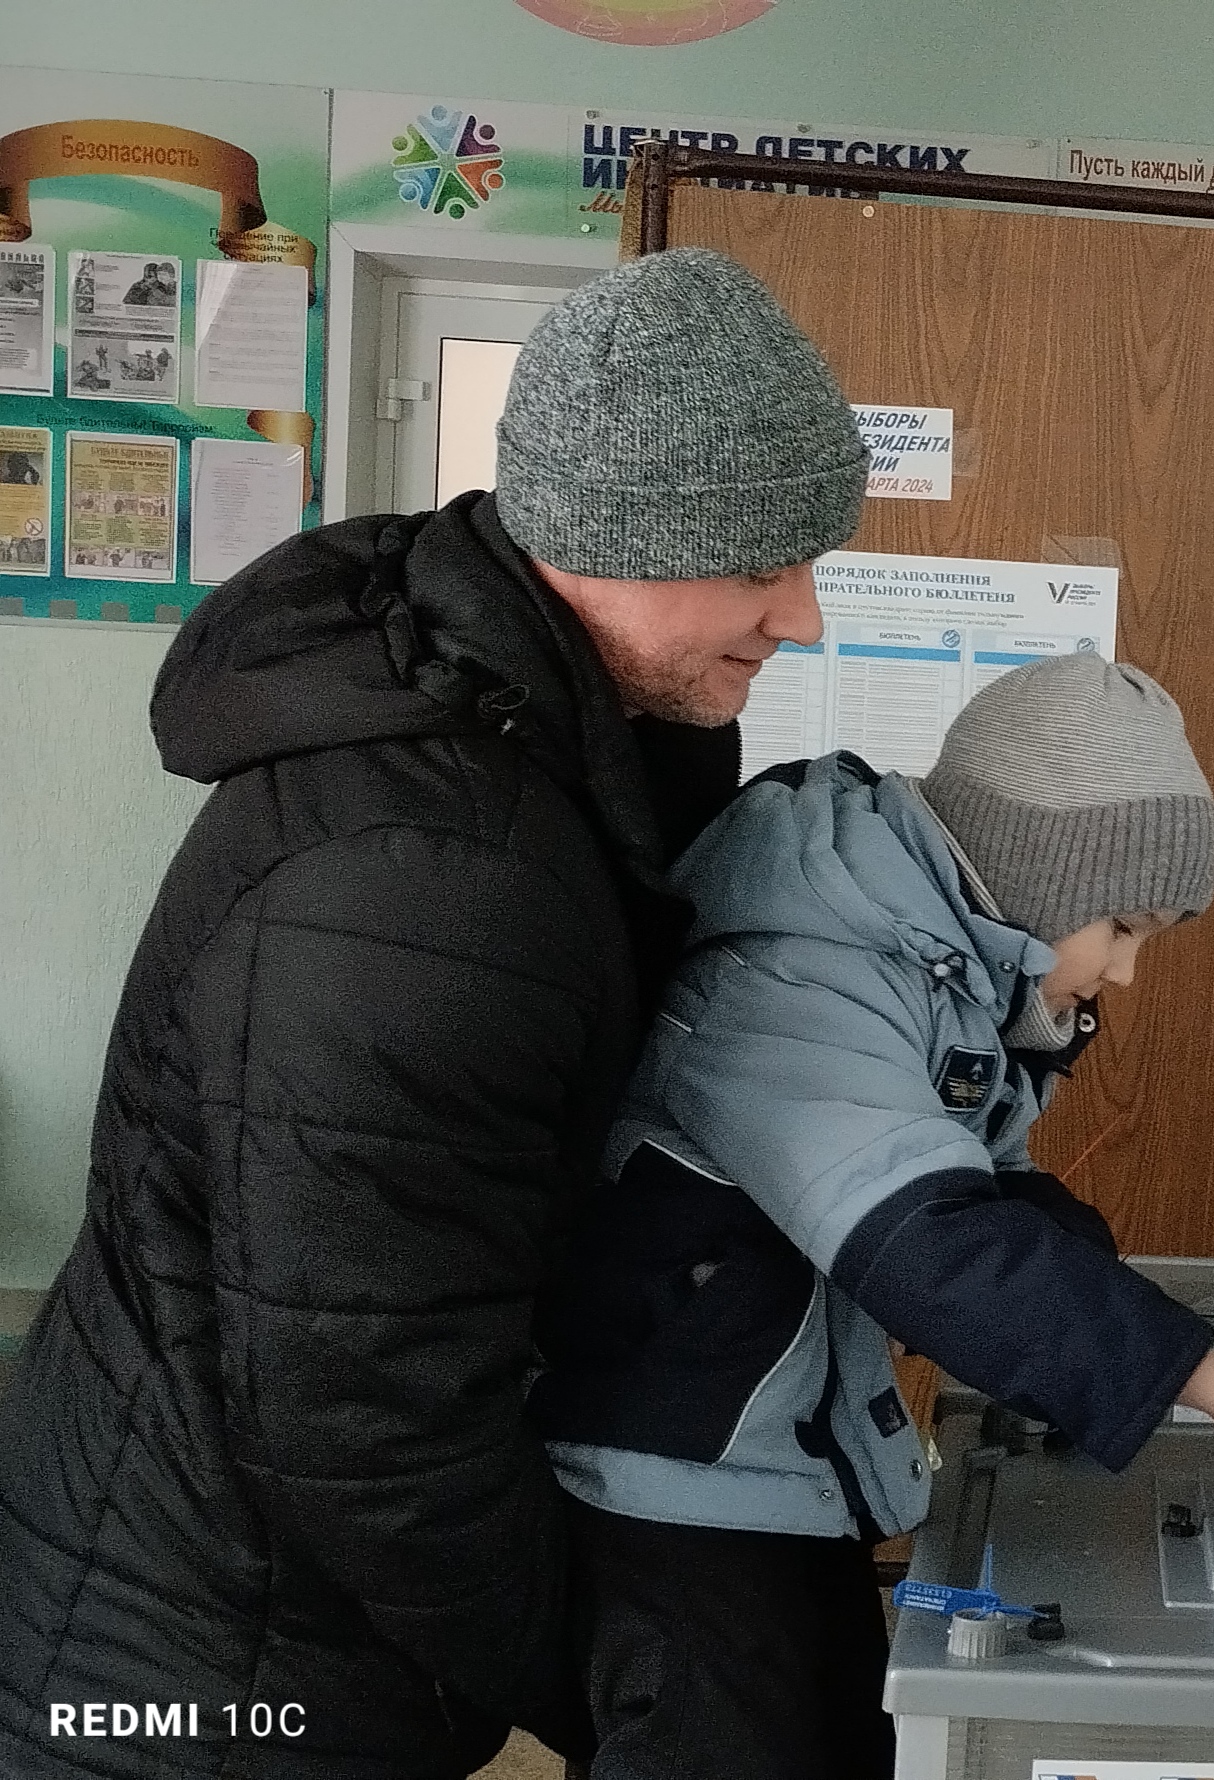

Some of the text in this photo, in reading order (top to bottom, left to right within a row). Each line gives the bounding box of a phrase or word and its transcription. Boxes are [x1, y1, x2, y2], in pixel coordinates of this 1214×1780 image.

[61, 134, 200, 167] Безопасность
[756, 135, 972, 172] ДЕТСКИХ
[1069, 149, 1125, 181] Пусть
[1131, 157, 1205, 185] каждый
[277, 234, 299, 244] при
[856, 411, 928, 430] ЫБОРЫ
[861, 433, 951, 453] ЕЗИДЕНТА
[867, 477, 934, 493] АРТА 2024
[815, 564, 992, 587] ПОРЯДОК ЗАПОЛНЕНИЯ
[815, 582, 1016, 603] ИРАТЕЛЬНОГО БЮЛЛЕТЕНЯ
